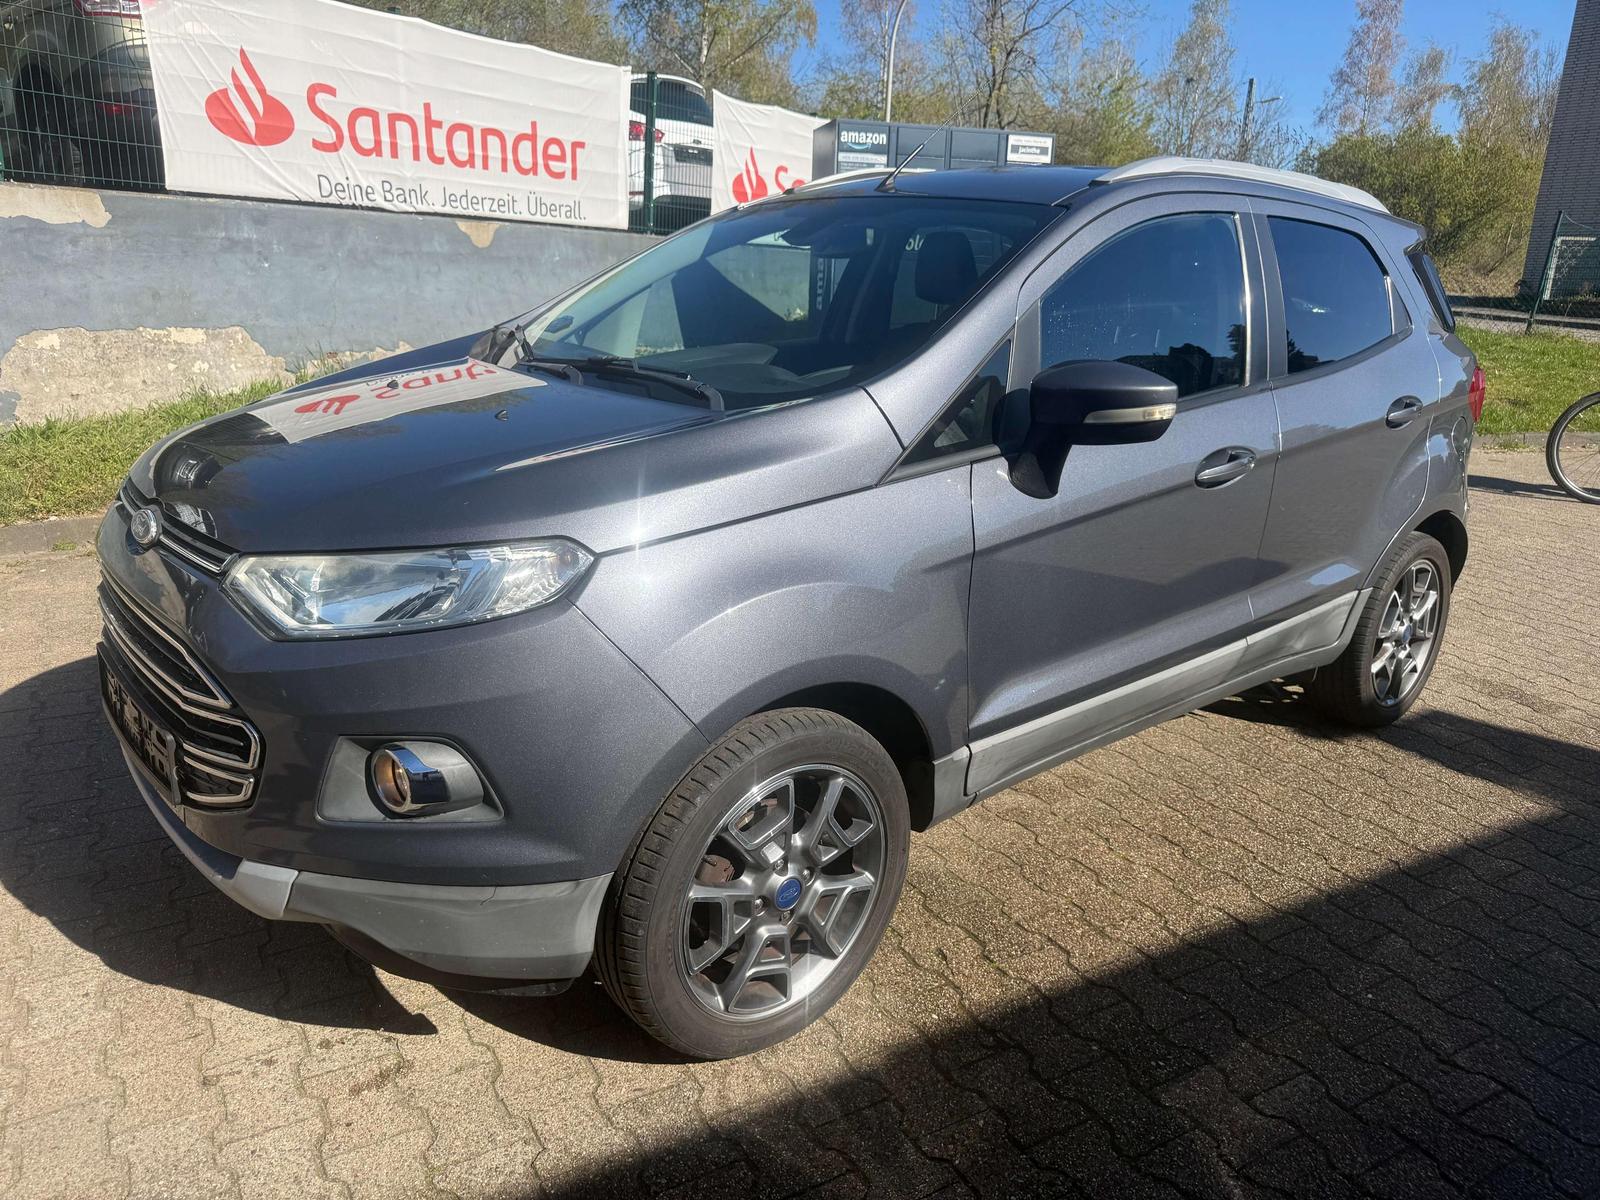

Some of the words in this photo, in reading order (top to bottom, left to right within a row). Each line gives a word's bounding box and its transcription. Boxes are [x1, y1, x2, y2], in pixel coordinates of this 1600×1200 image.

[306, 82, 586, 181] Santander
[840, 130, 887, 146] amazon
[317, 174, 377, 202] Deine
[381, 180, 436, 207] Bank.
[440, 186, 523, 215] Jederzeit.
[527, 191, 587, 221] Überall.
